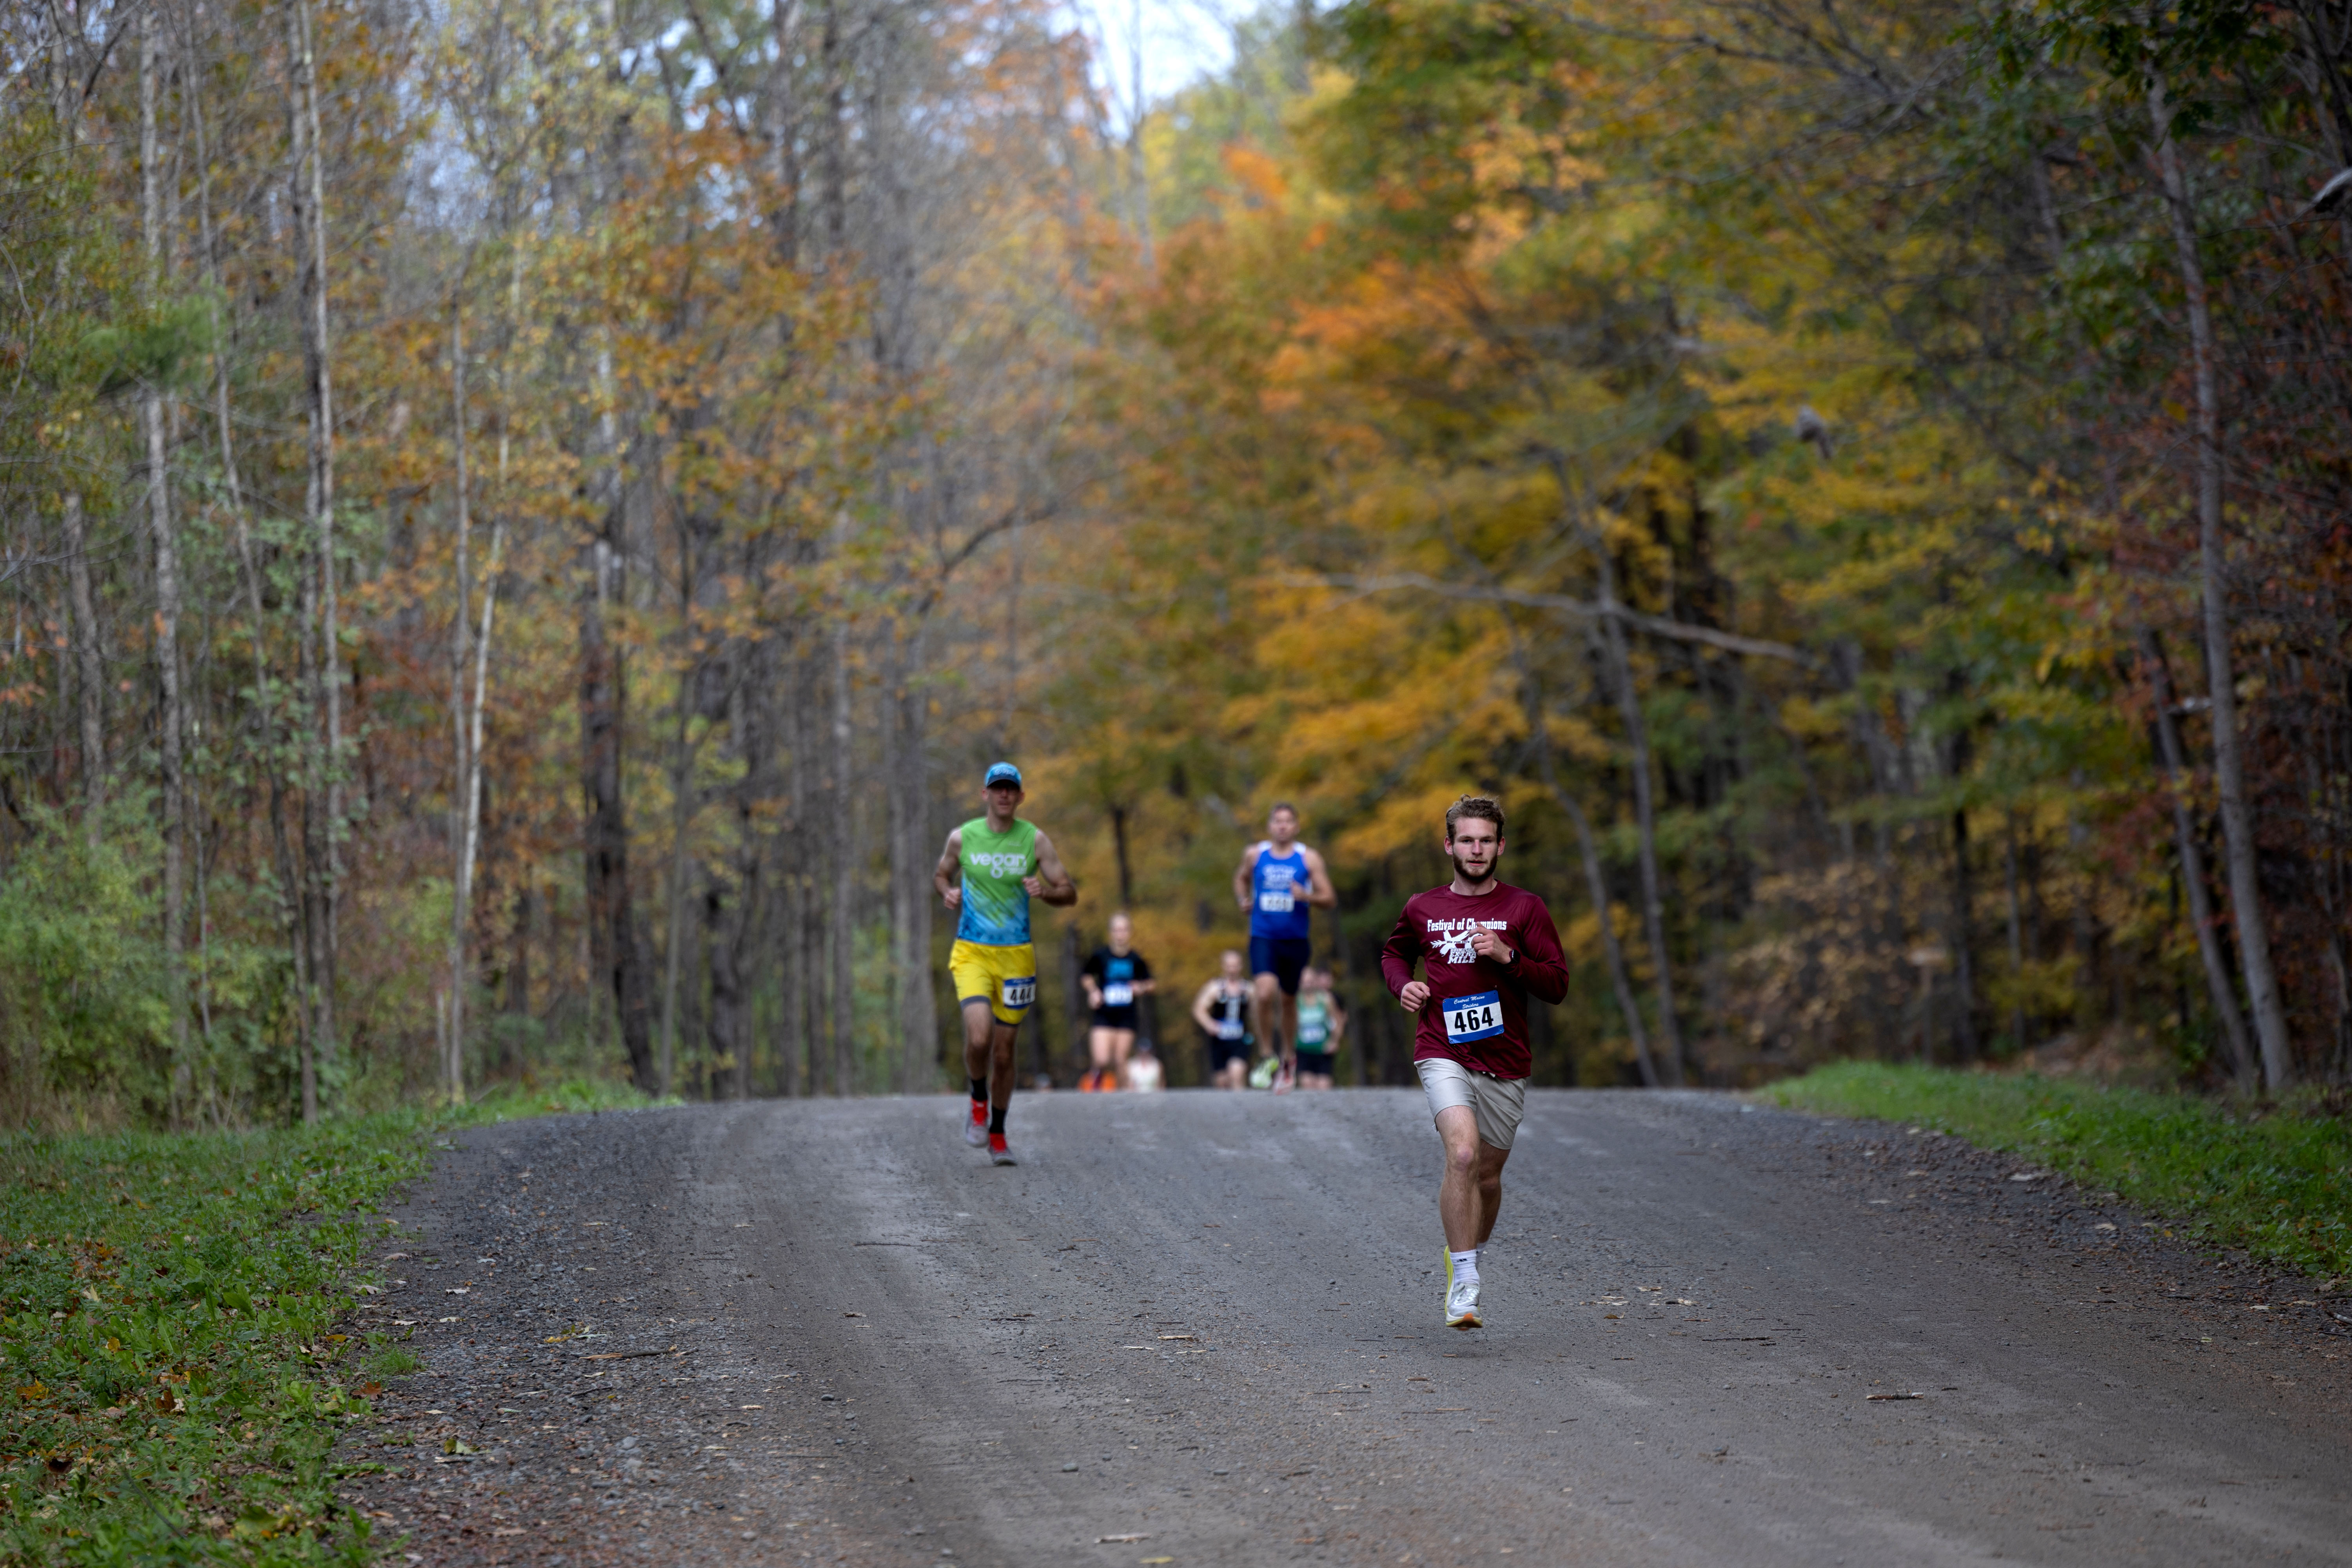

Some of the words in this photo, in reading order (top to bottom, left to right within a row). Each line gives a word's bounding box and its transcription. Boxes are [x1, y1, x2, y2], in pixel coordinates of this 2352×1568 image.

[970, 853, 1027, 878] vegan
[1427, 918, 1455, 932] Festival
[1457, 918, 1465, 930] of
[1466, 918, 1507, 930] Chmpions
[1010, 987, 1031, 1004] 444
[1454, 1006, 1494, 1033] 464
